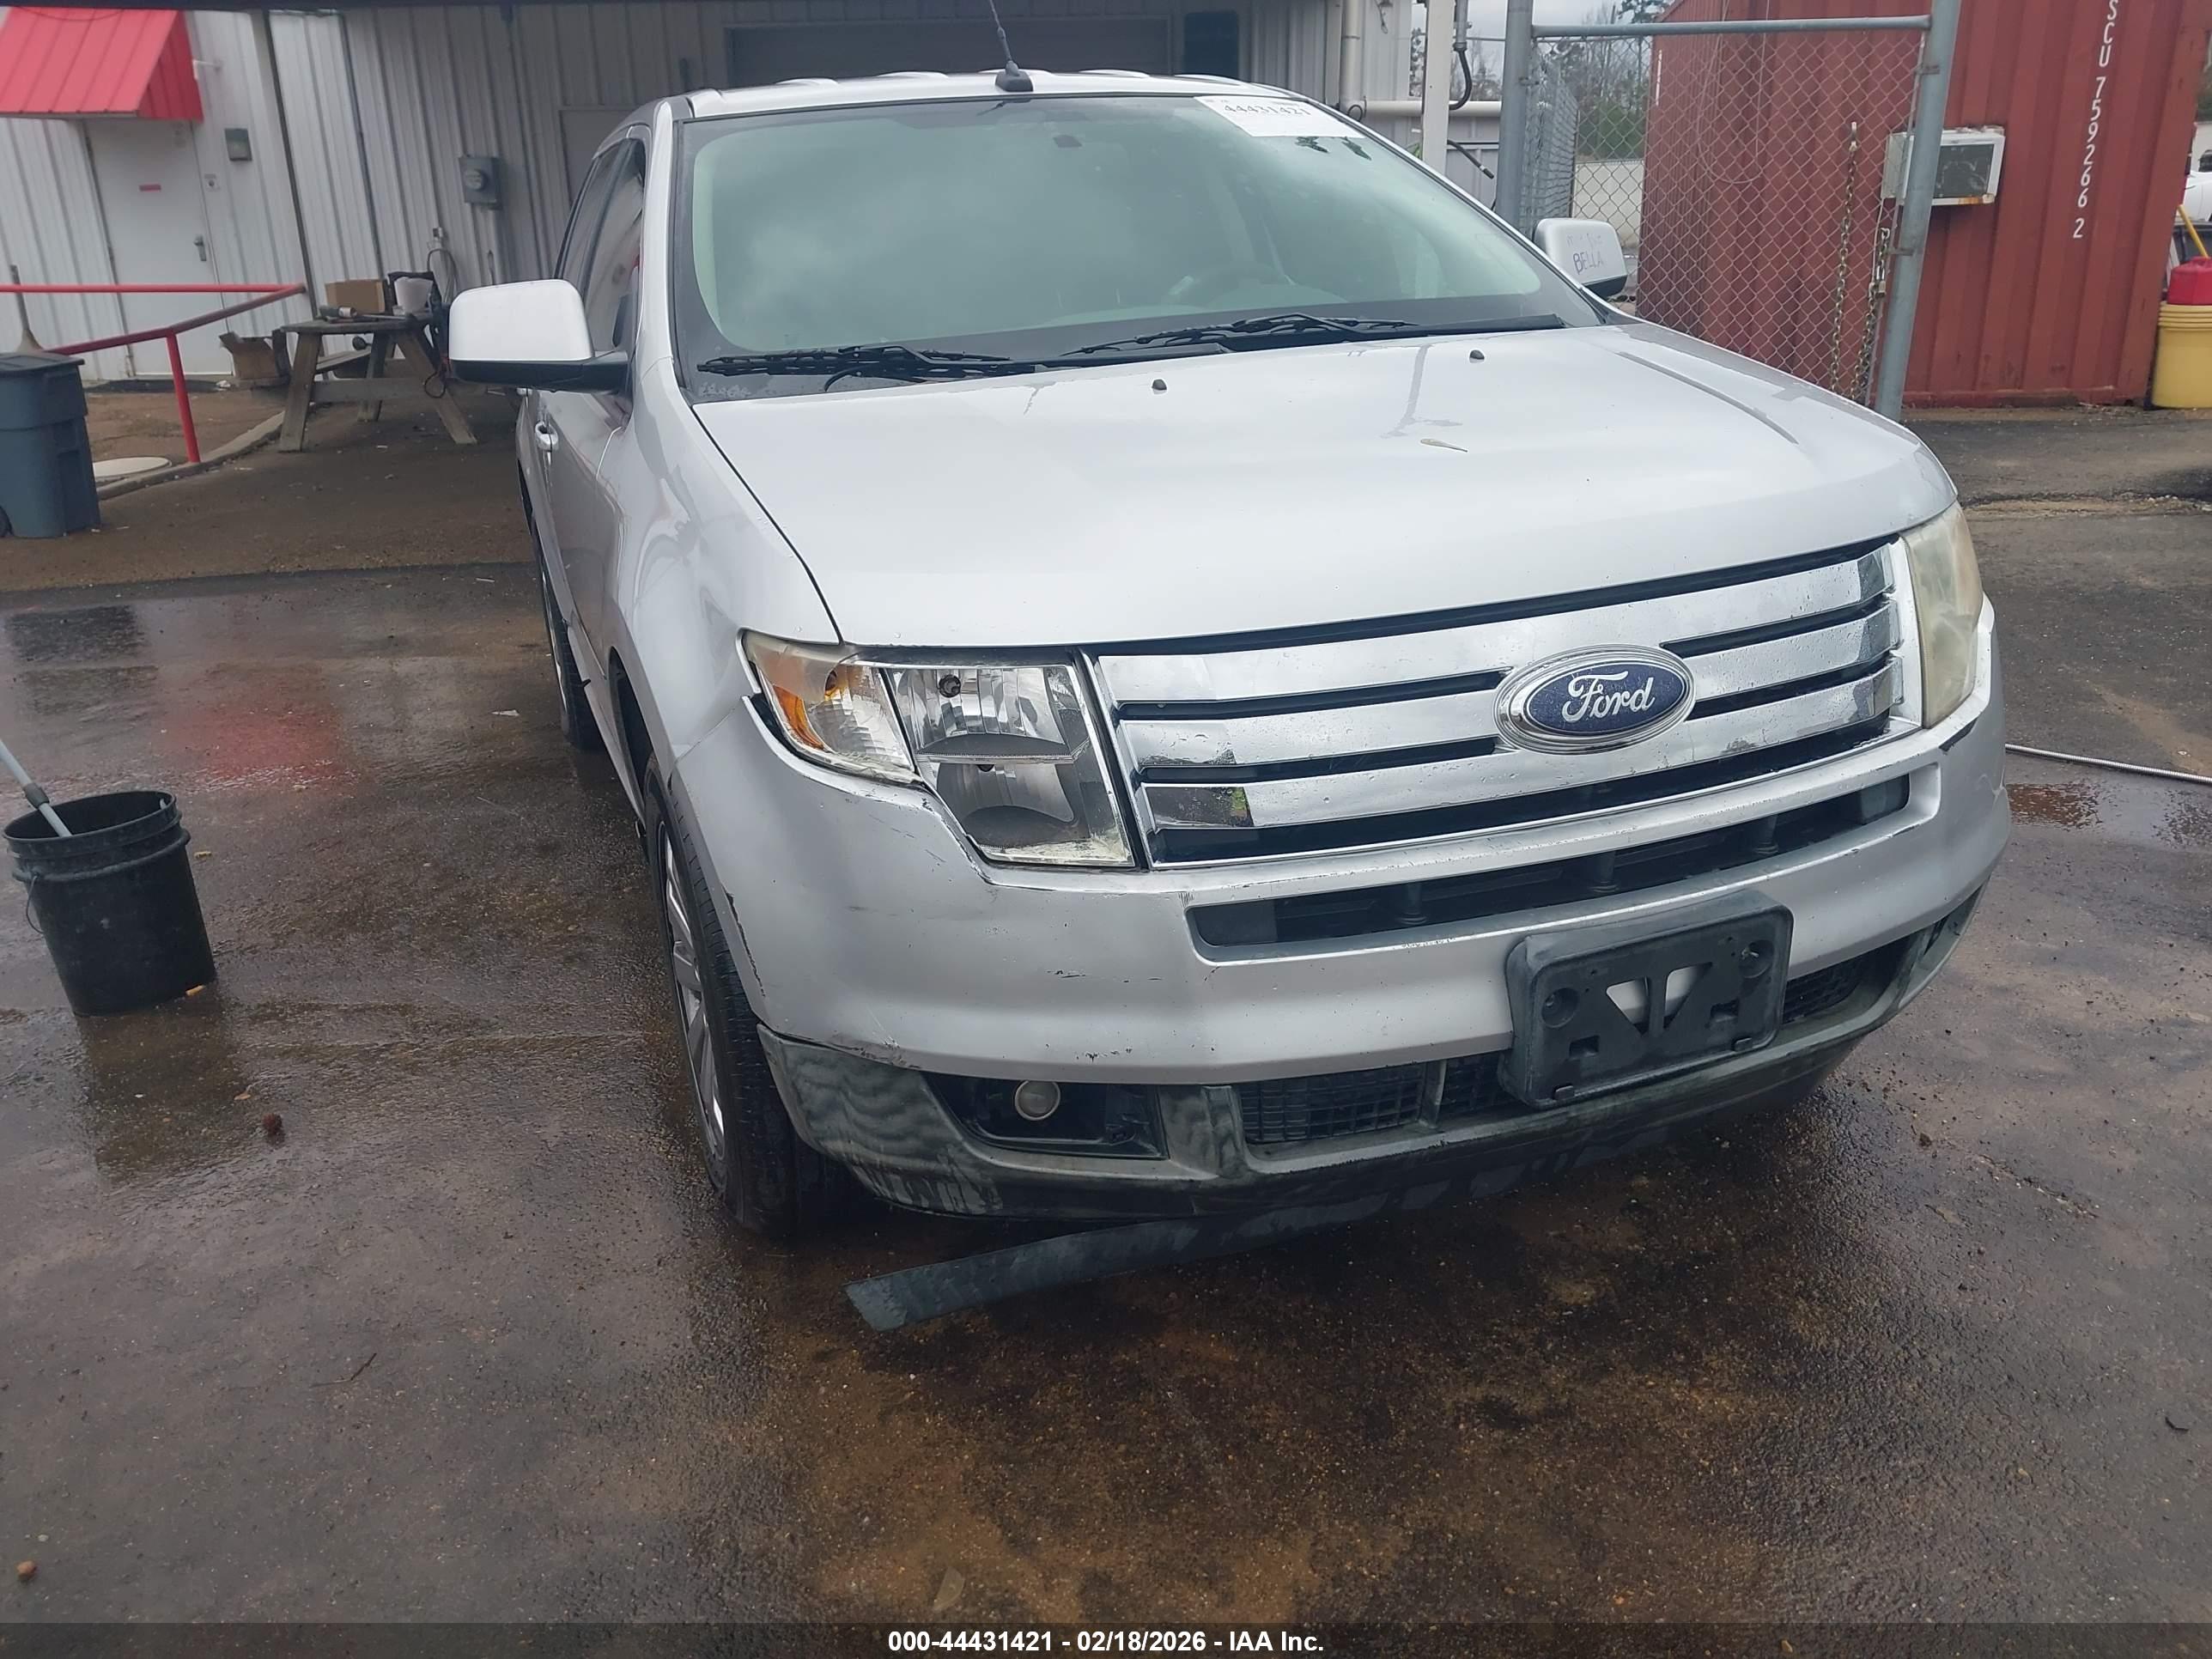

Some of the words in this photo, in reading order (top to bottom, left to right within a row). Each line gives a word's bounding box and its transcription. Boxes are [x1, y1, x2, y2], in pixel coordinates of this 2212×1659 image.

[1224, 105, 1311, 116] 44431421
[2076, 76, 2106, 208] 759266
[2072, 217, 2085, 239] 2
[1561, 671, 1656, 723] Ford
